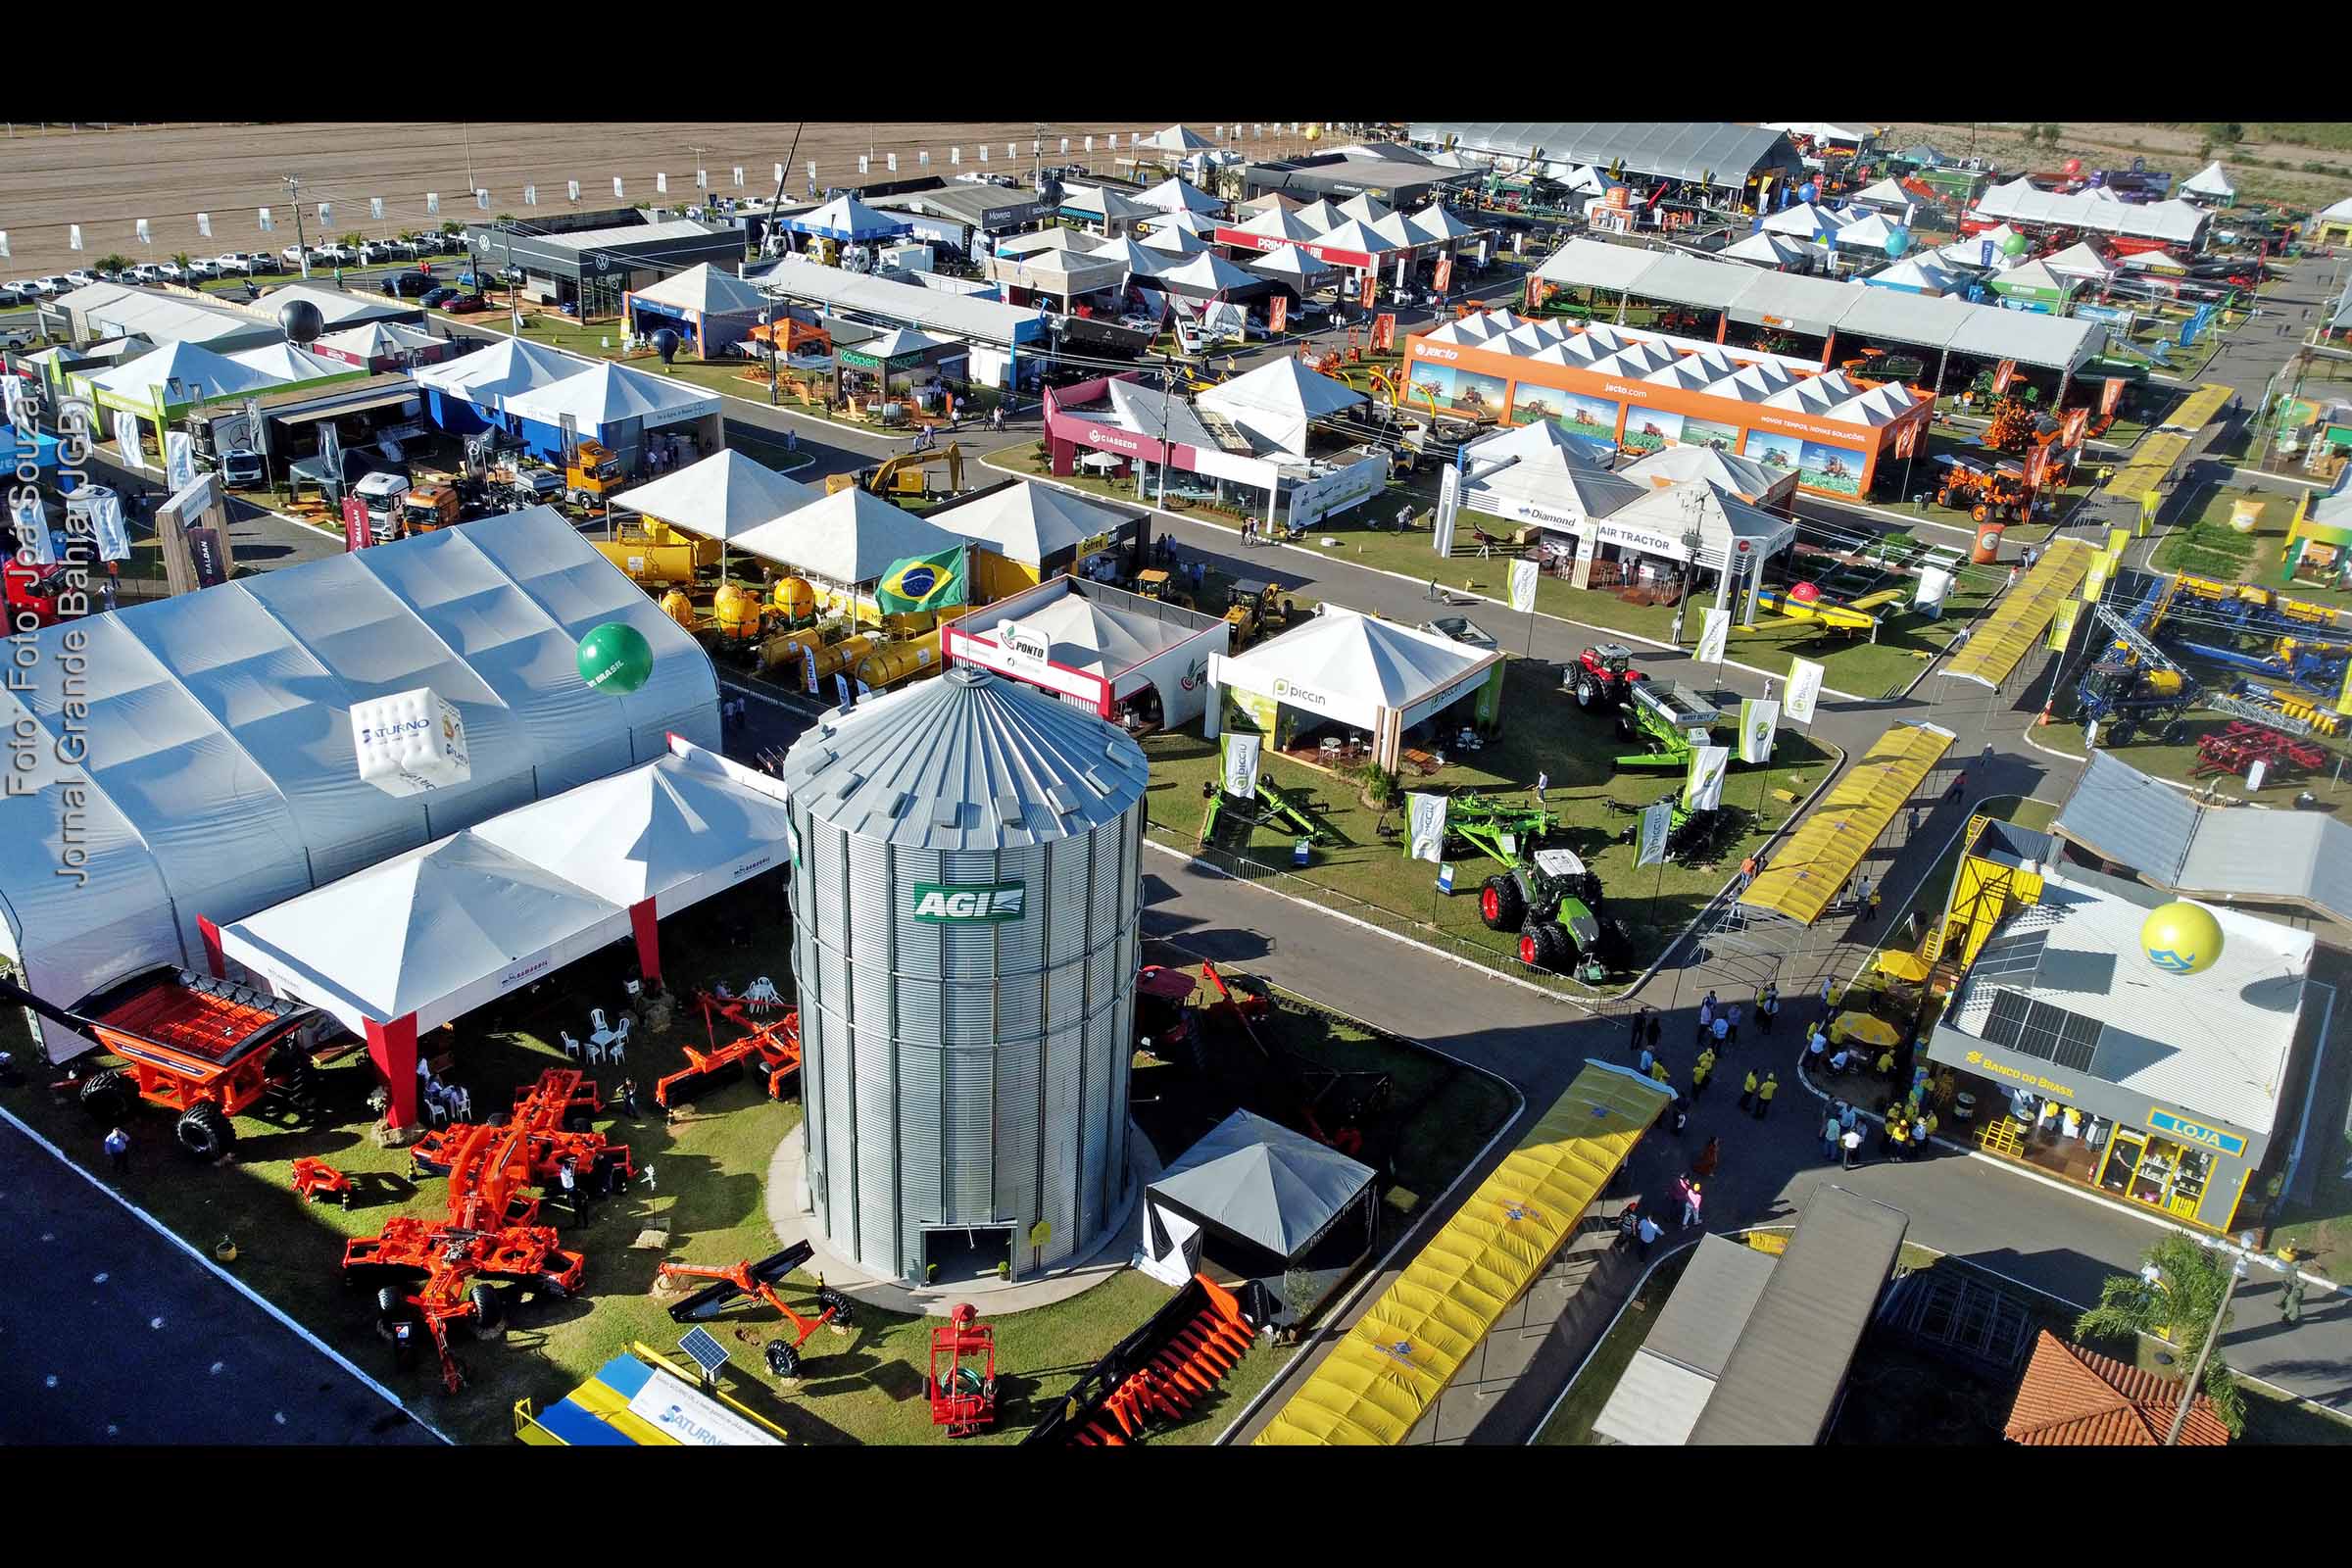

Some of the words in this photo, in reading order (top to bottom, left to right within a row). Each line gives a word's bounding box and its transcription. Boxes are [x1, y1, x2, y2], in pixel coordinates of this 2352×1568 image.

[840, 349, 879, 368] Koppert
[888, 351, 925, 369] Koppert
[1424, 344, 1458, 361] jacto
[1605, 382, 1647, 399] jacto.com
[1760, 416, 1783, 425] NOVOS
[1810, 425, 1831, 436] NOVAS
[1531, 508, 1577, 527] Diamond
[1598, 525, 1617, 539] AIR
[1621, 530, 1670, 551] TRACTOR
[205, 540, 214, 576] BALDAN
[1015, 641, 1045, 659] PONTO
[1290, 685, 1326, 707] piccin
[915, 892, 991, 917] AGI
[1983, 1058, 2021, 1079] BANCO
[2022, 1073, 2037, 1085] DO
[2038, 1076, 2076, 1099] BRASIL
[2171, 1119, 2221, 1148] LOJA
